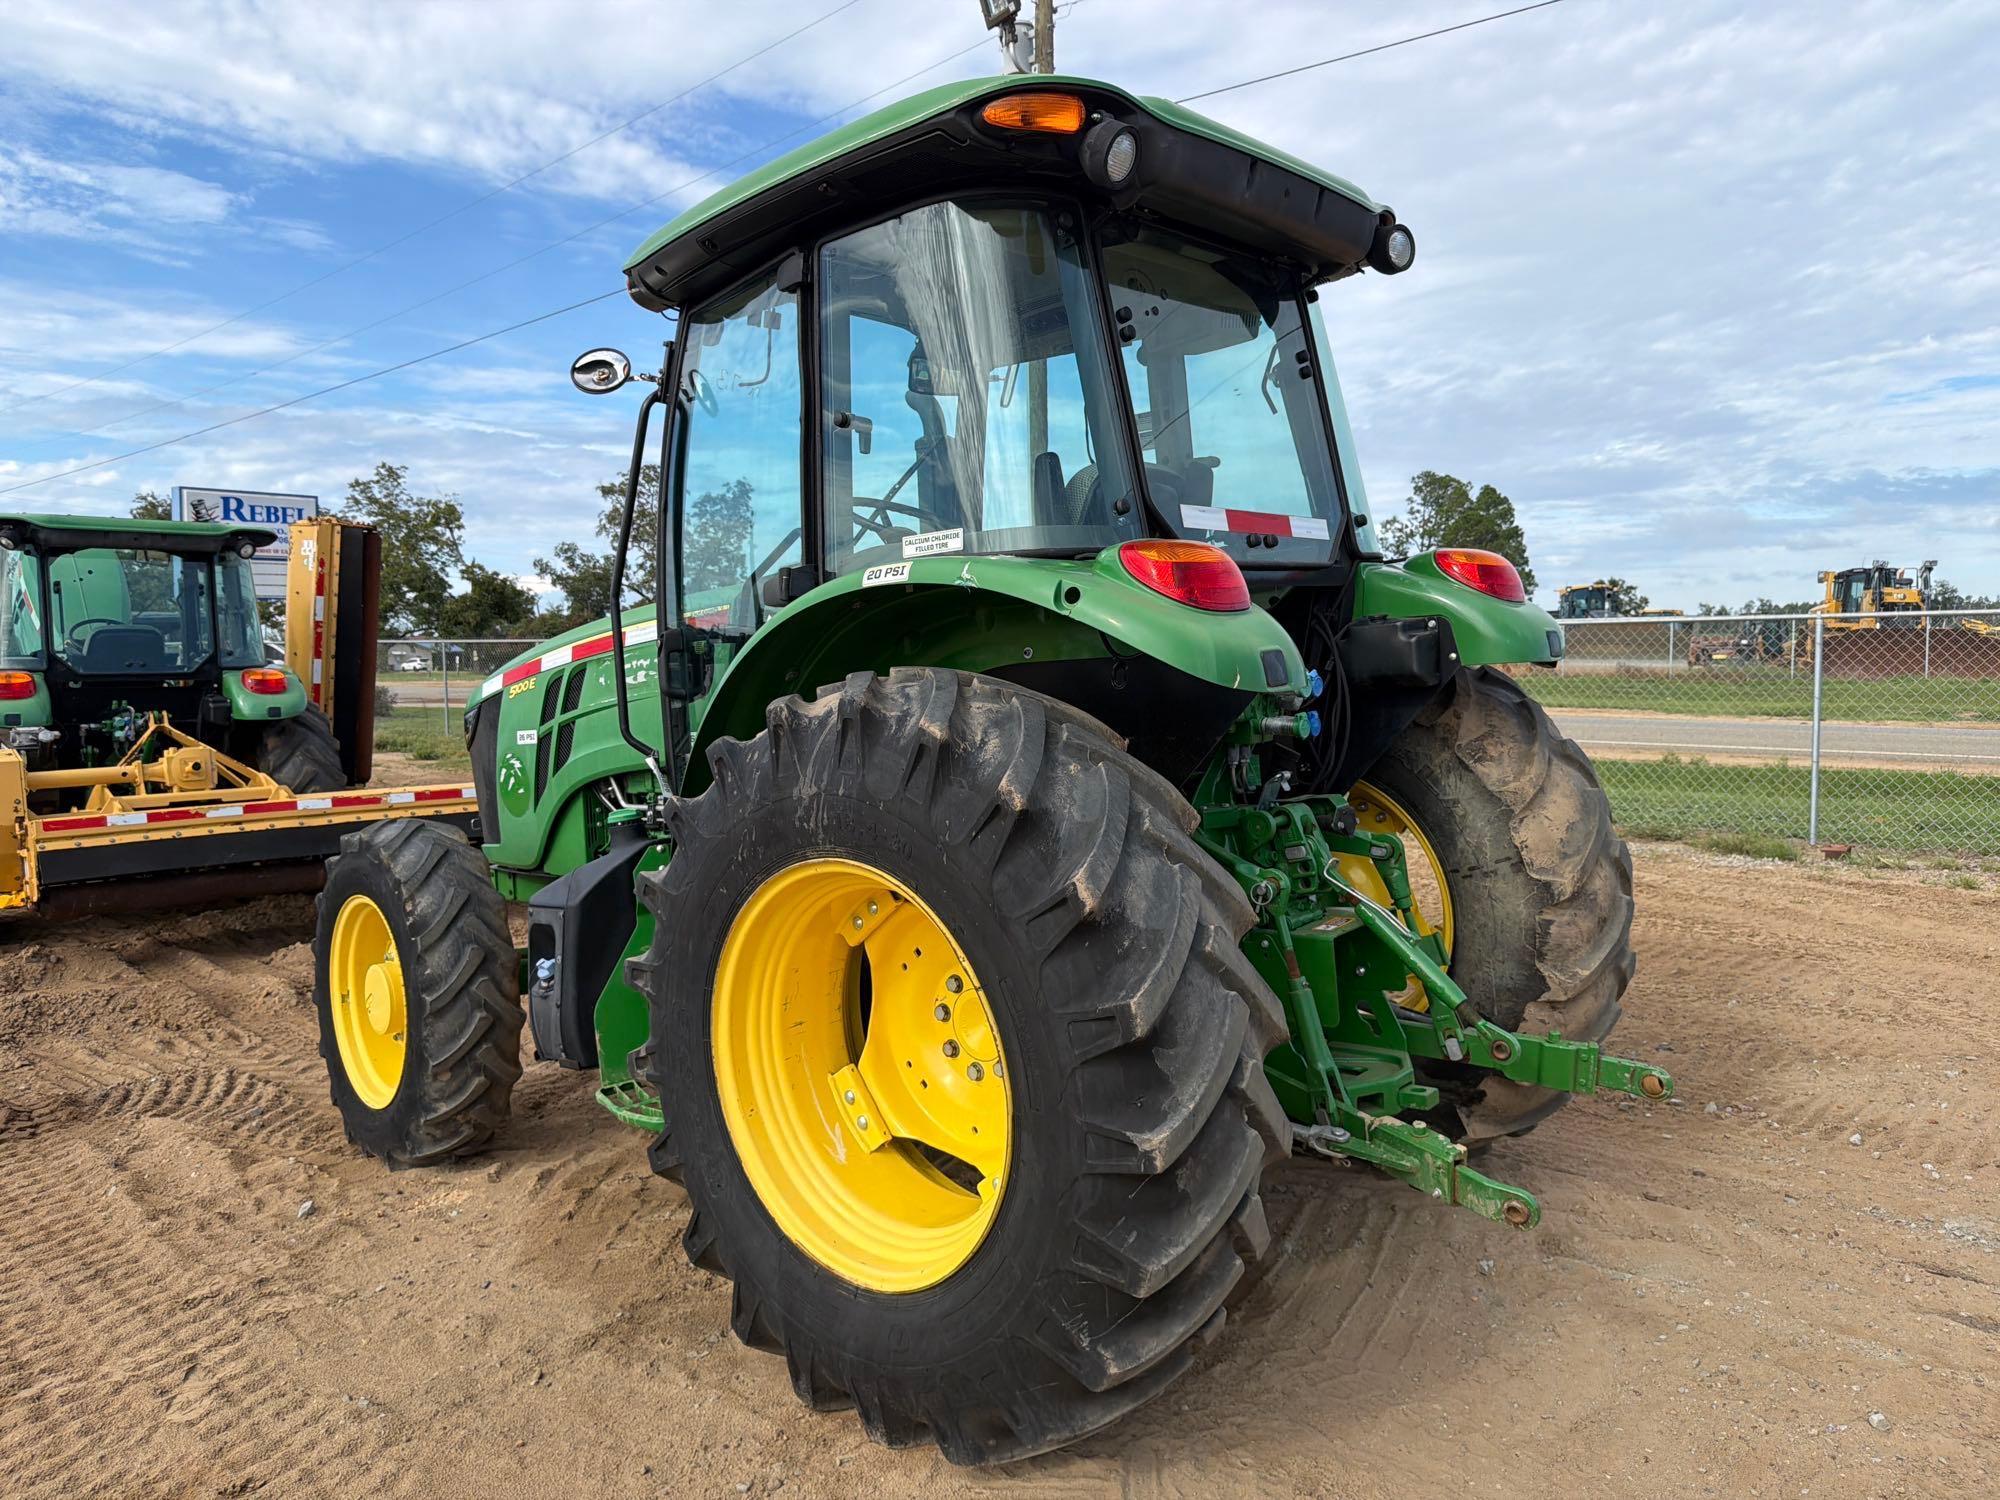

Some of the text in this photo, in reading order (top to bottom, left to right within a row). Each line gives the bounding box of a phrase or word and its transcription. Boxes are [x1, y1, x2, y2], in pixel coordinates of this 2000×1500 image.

[220, 496, 305, 524] REBEL
[904, 532, 960, 546] CALCIUM CHLORIDE
[915, 542, 949, 552] FILLED TIRE
[867, 565, 907, 581] 20 PSI
[525, 733, 536, 741] PSI
